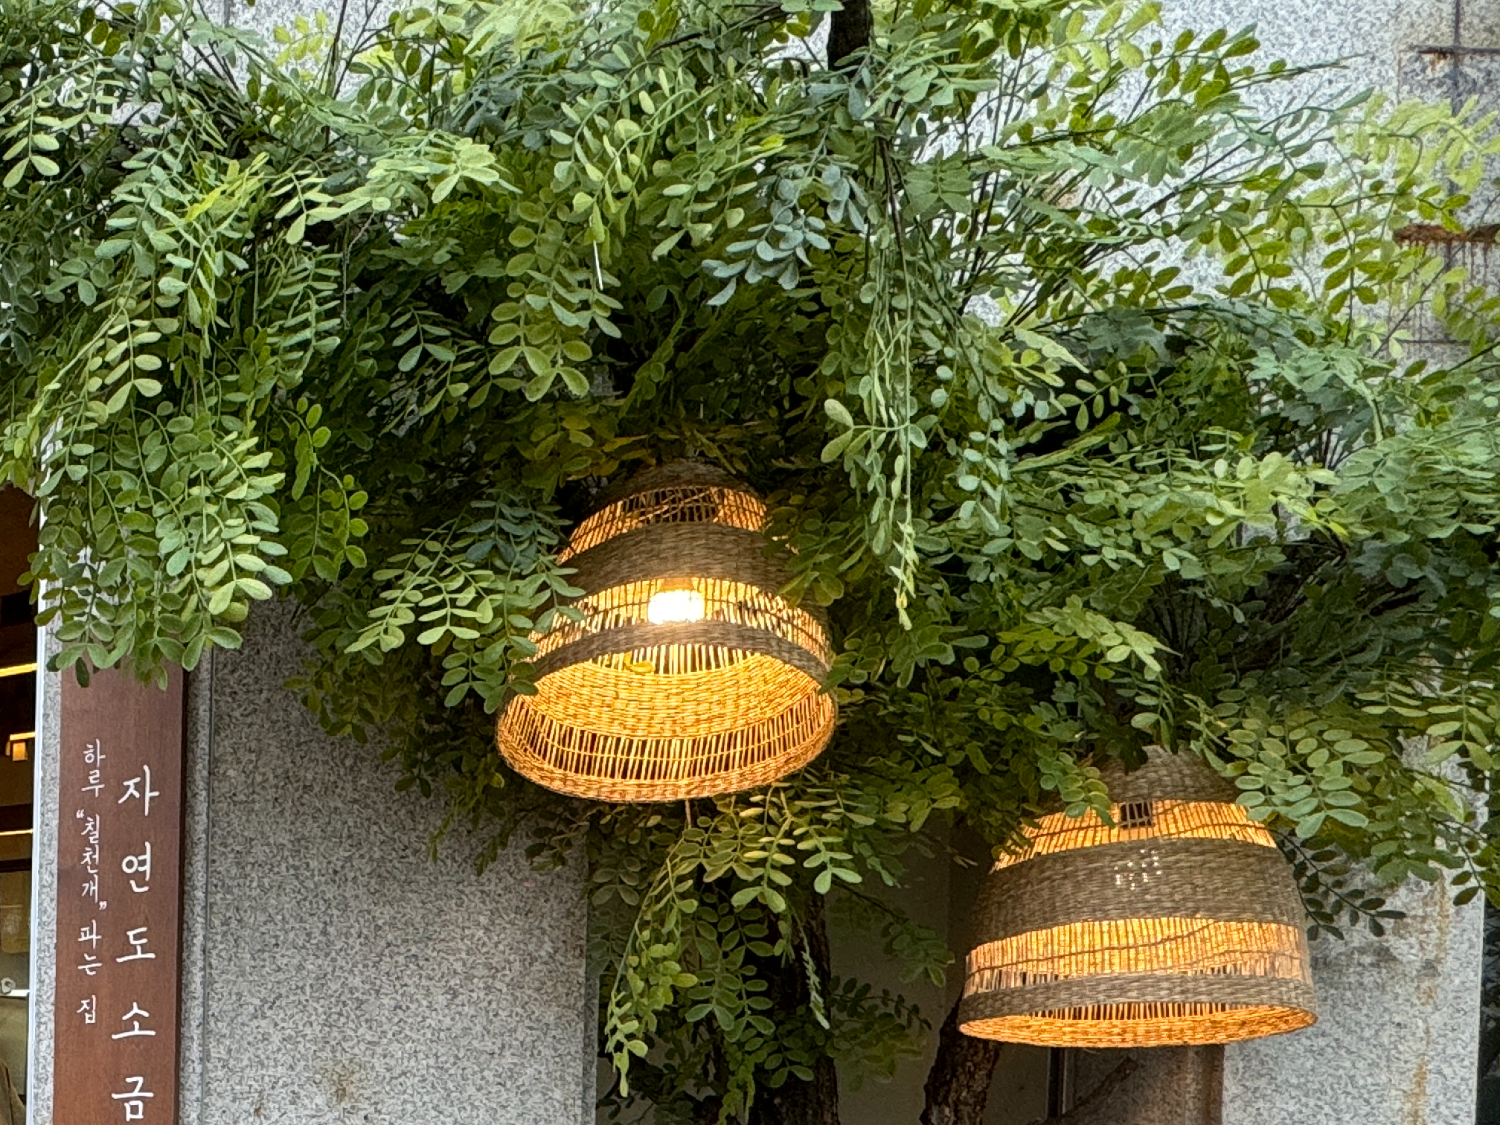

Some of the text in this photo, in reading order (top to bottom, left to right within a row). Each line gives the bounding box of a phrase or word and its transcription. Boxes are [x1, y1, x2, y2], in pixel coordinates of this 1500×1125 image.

[81, 738, 106, 798] 하루
[77, 919, 102, 976] 파는
[76, 995, 97, 1024] 집
